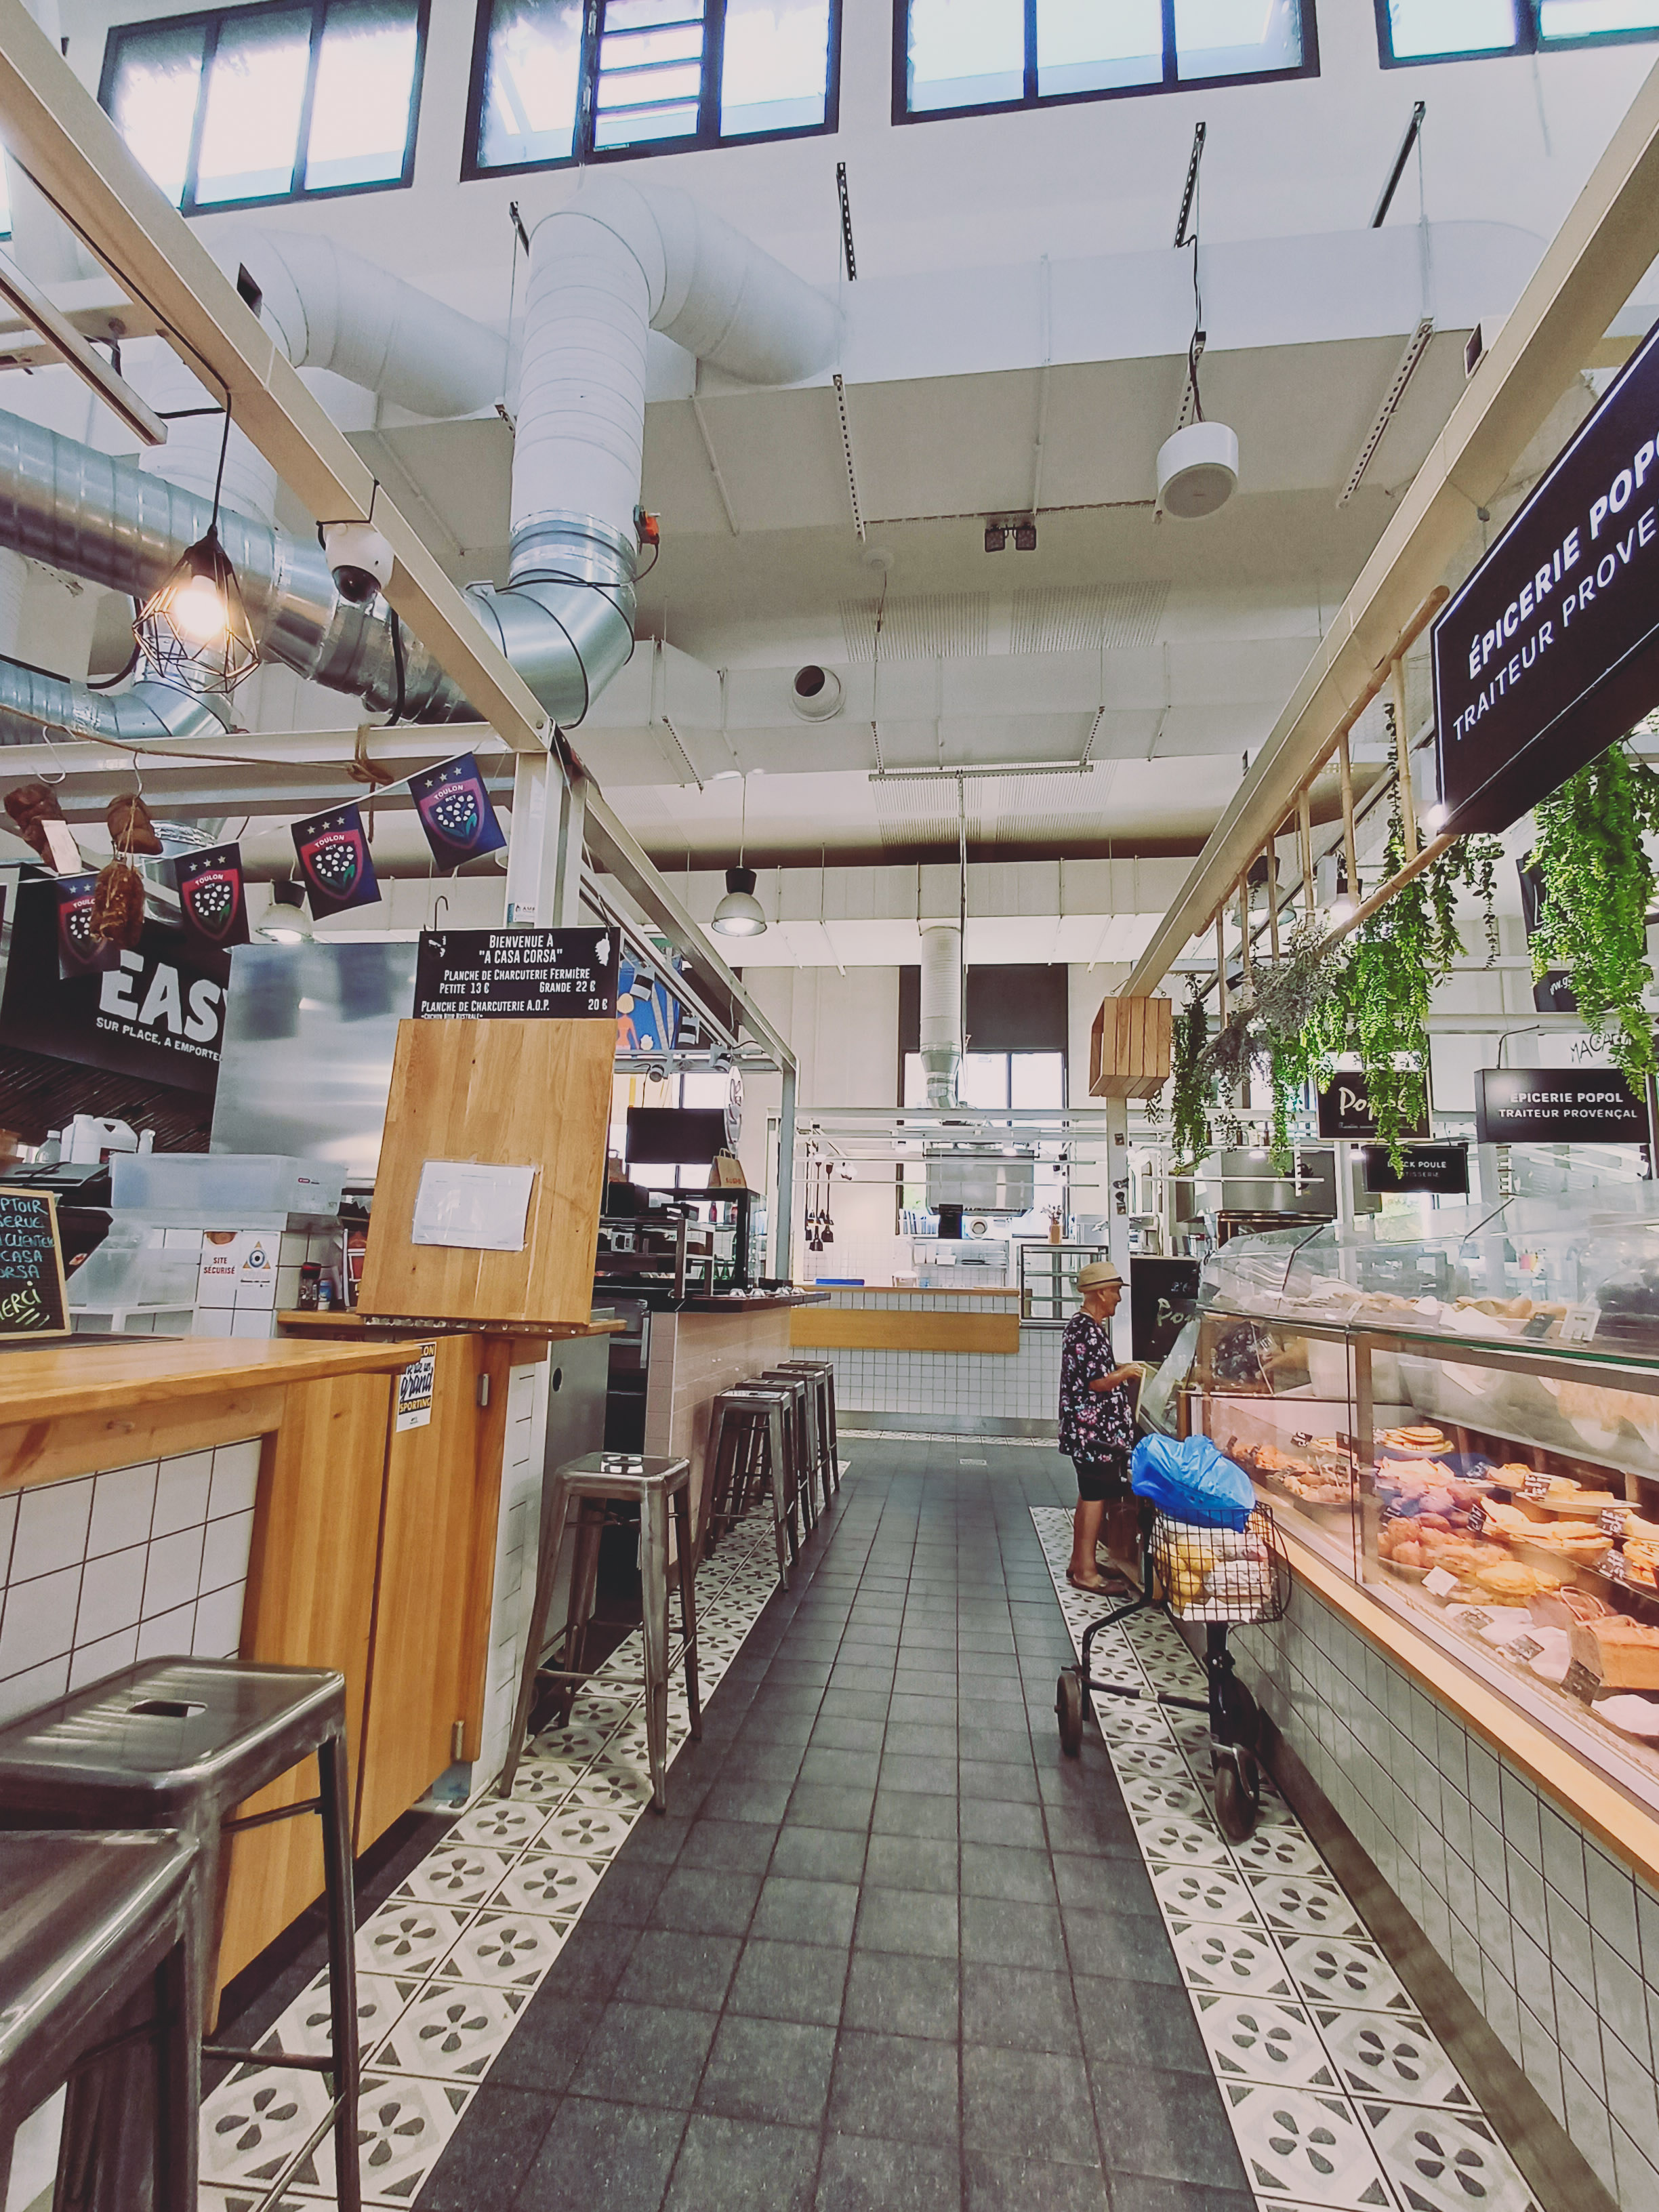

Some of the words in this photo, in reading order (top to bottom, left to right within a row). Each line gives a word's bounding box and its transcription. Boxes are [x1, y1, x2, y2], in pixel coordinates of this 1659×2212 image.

[1469, 526, 1580, 680] ÉPICERIE
[1453, 621, 1553, 740] TRAITEUR
[1563, 504, 1659, 627] PROVE
[434, 785, 464, 800] TOULON
[314, 835, 344, 848] TOULON
[195, 874, 224, 885] TOULON
[73, 899, 96, 908] TOULO
[489, 935, 544, 948] BIENVENUE
[546, 933, 554, 947] À
[494, 949, 520, 964] CASA
[523, 949, 562, 964] CORSA"
[444, 970, 479, 981] PLANCHE
[481, 970, 492, 981] DE
[494, 968, 548, 980] CHARCUTERIE
[550, 967, 590, 979] FERMIÈRE
[440, 983, 466, 994] PETITE
[470, 983, 481, 994] 13
[539, 981, 571, 993] GRANDE
[575, 981, 587, 992] 22
[100, 949, 229, 1042] EAS
[422, 1001, 457, 1012] PLANCHE
[459, 1002, 469, 1012] DE
[471, 1000, 525, 1012] CHARCUTERIE
[527, 999, 550, 1011] A.O.P.
[588, 999, 600, 1010] 20
[96, 1017, 119, 1031] SUR
[122, 1025, 161, 1046] PLACE,
[164, 1038, 171, 1047] A
[174, 1040, 222, 1061] EMPORTE
[1578, 1092, 1624, 1103] POPOL
[1499, 1109, 1559, 1118] TRAITEUR
[1563, 1109, 1638, 1120] PROVENÇAL
[0, 1197, 49, 1214] PTOIR
[0, 1250, 43, 1263] CASA
[0, 1265, 40, 1278] ORSA
[420, 1345, 434, 1356] ON
[400, 1366, 433, 1403] grand
[399, 1397, 431, 1413] SPORTING
